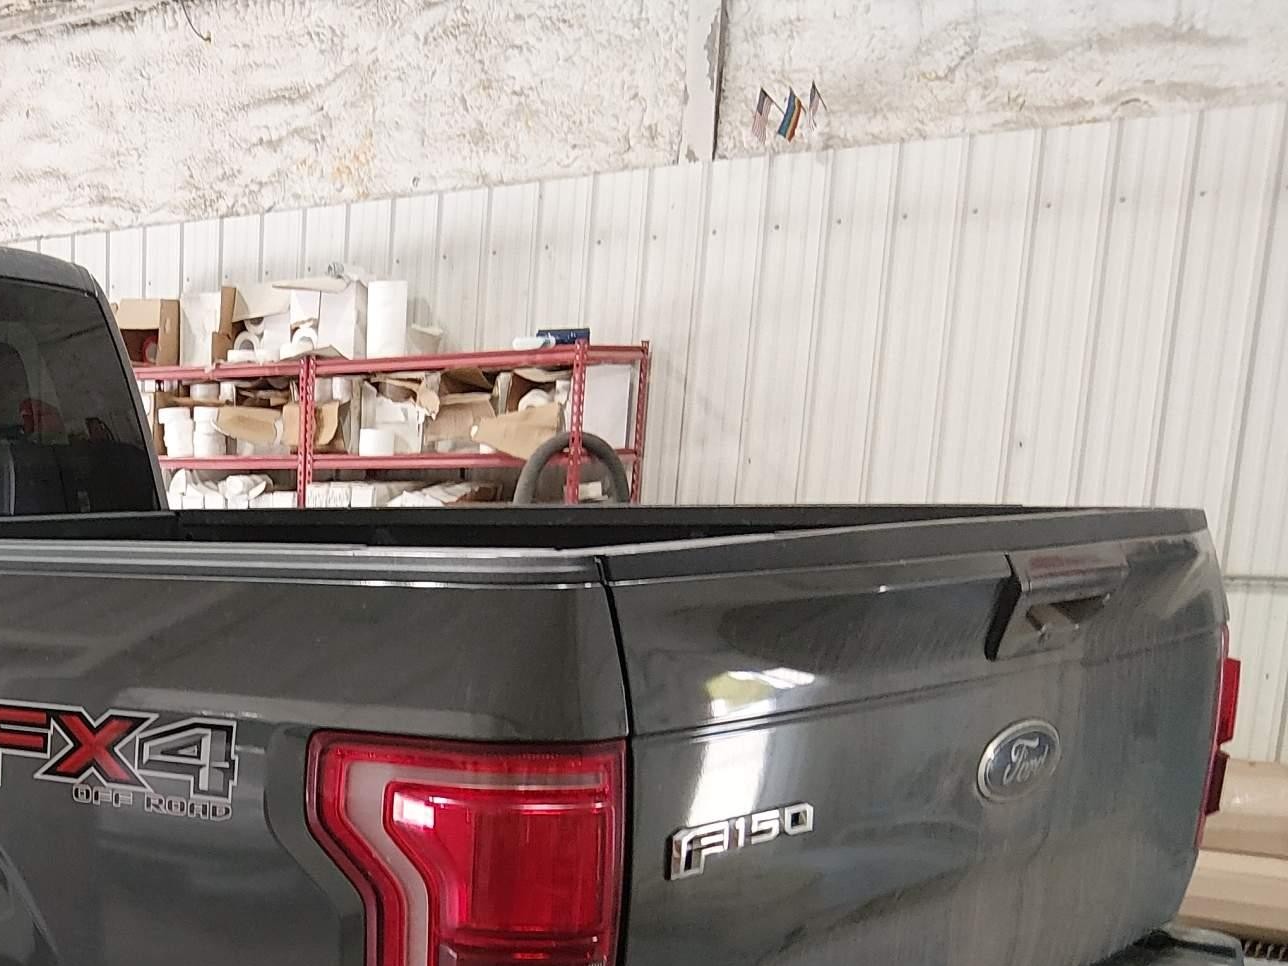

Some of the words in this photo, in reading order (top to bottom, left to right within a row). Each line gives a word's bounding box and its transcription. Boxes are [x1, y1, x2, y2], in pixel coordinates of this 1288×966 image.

[1001, 736, 1050, 786] Ford
[72, 784, 133, 808] OFF
[144, 792, 232, 821] ROAD
